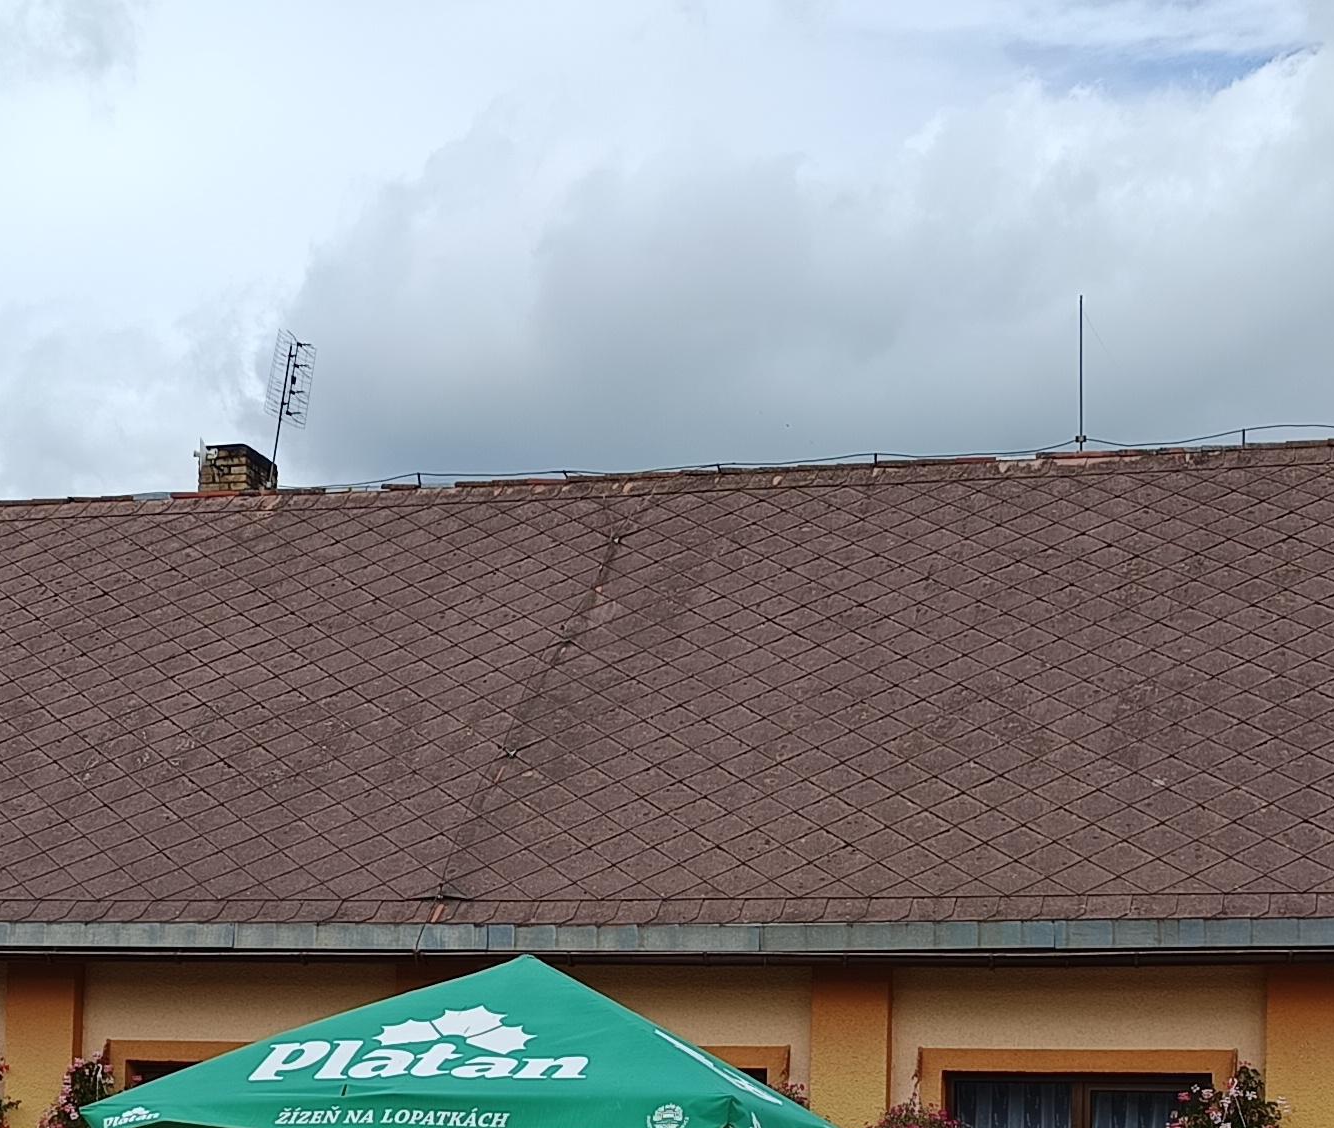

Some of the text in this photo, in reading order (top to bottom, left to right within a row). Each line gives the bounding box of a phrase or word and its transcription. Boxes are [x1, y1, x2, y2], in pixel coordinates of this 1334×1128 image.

[248, 1041, 588, 1081] Platan
[275, 1106, 510, 1128] ŽÍZEŇ NA LOPATKÁCH
